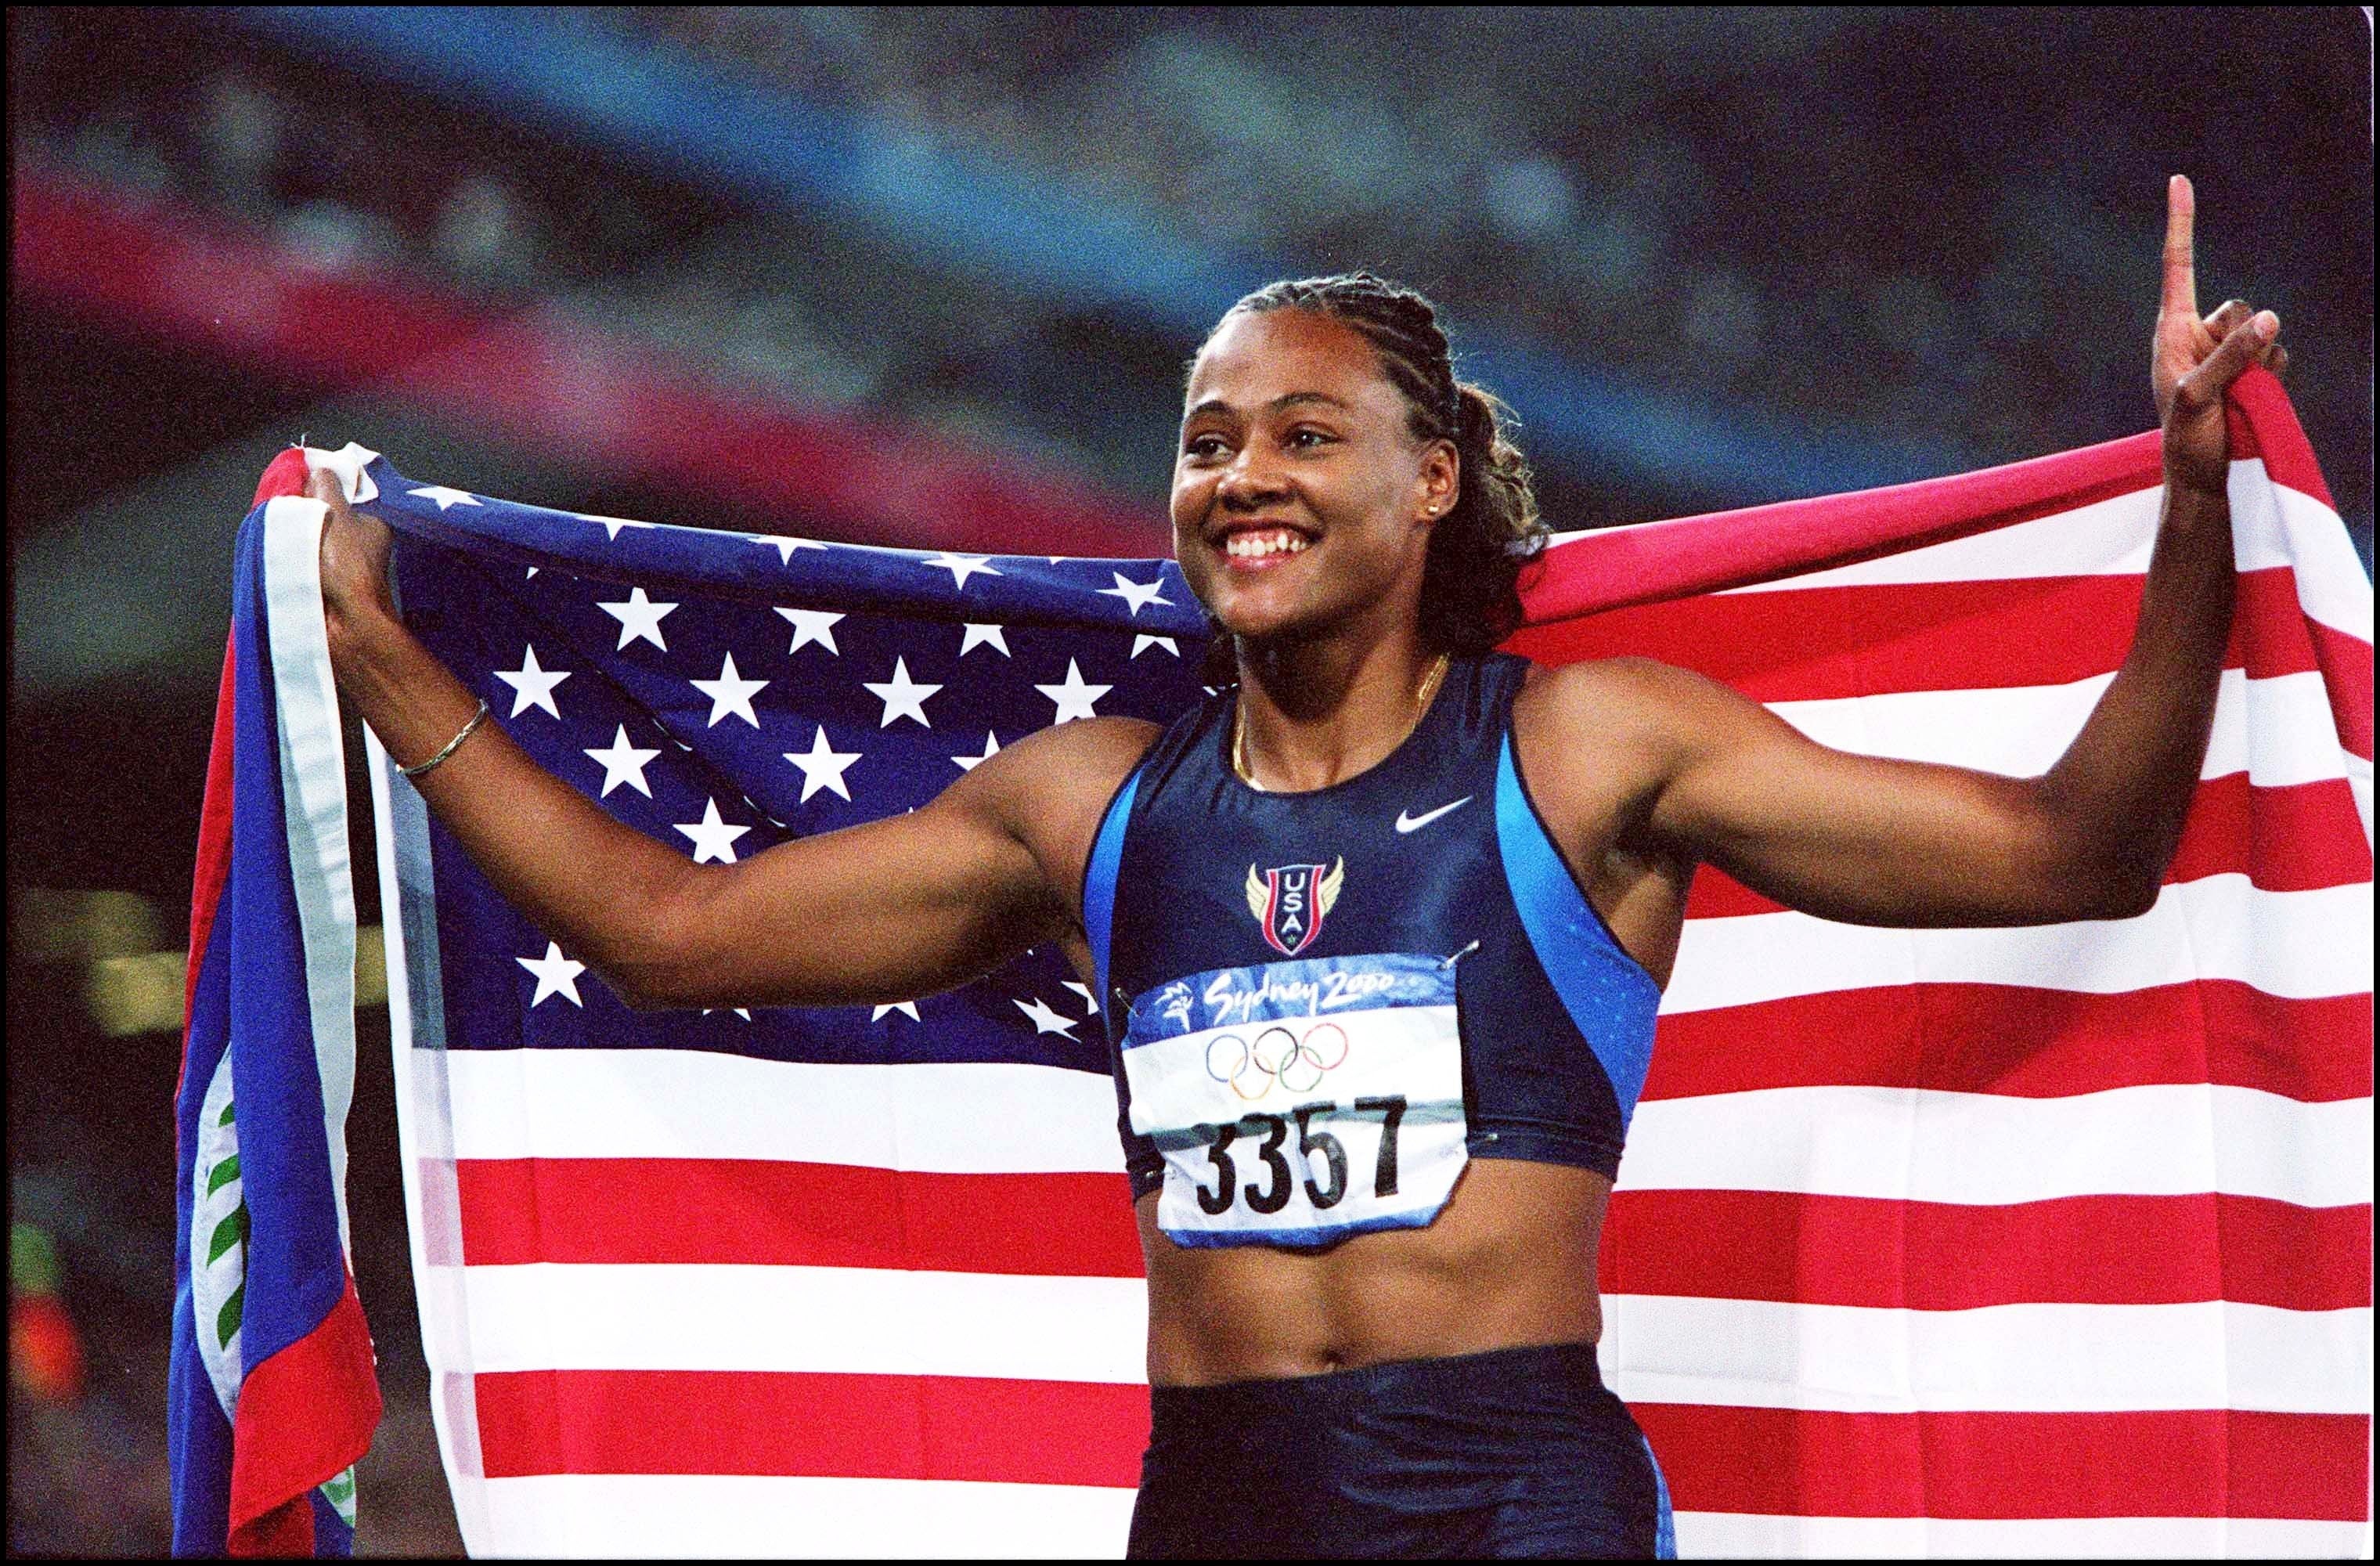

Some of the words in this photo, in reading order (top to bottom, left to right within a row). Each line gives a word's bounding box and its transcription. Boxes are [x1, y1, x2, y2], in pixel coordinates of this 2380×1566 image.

[1281, 872, 1306, 934] USA
[1204, 974, 1318, 1023] Sydney
[1322, 972, 1394, 1008] 2000
[1192, 1095, 1406, 1214] 3357
